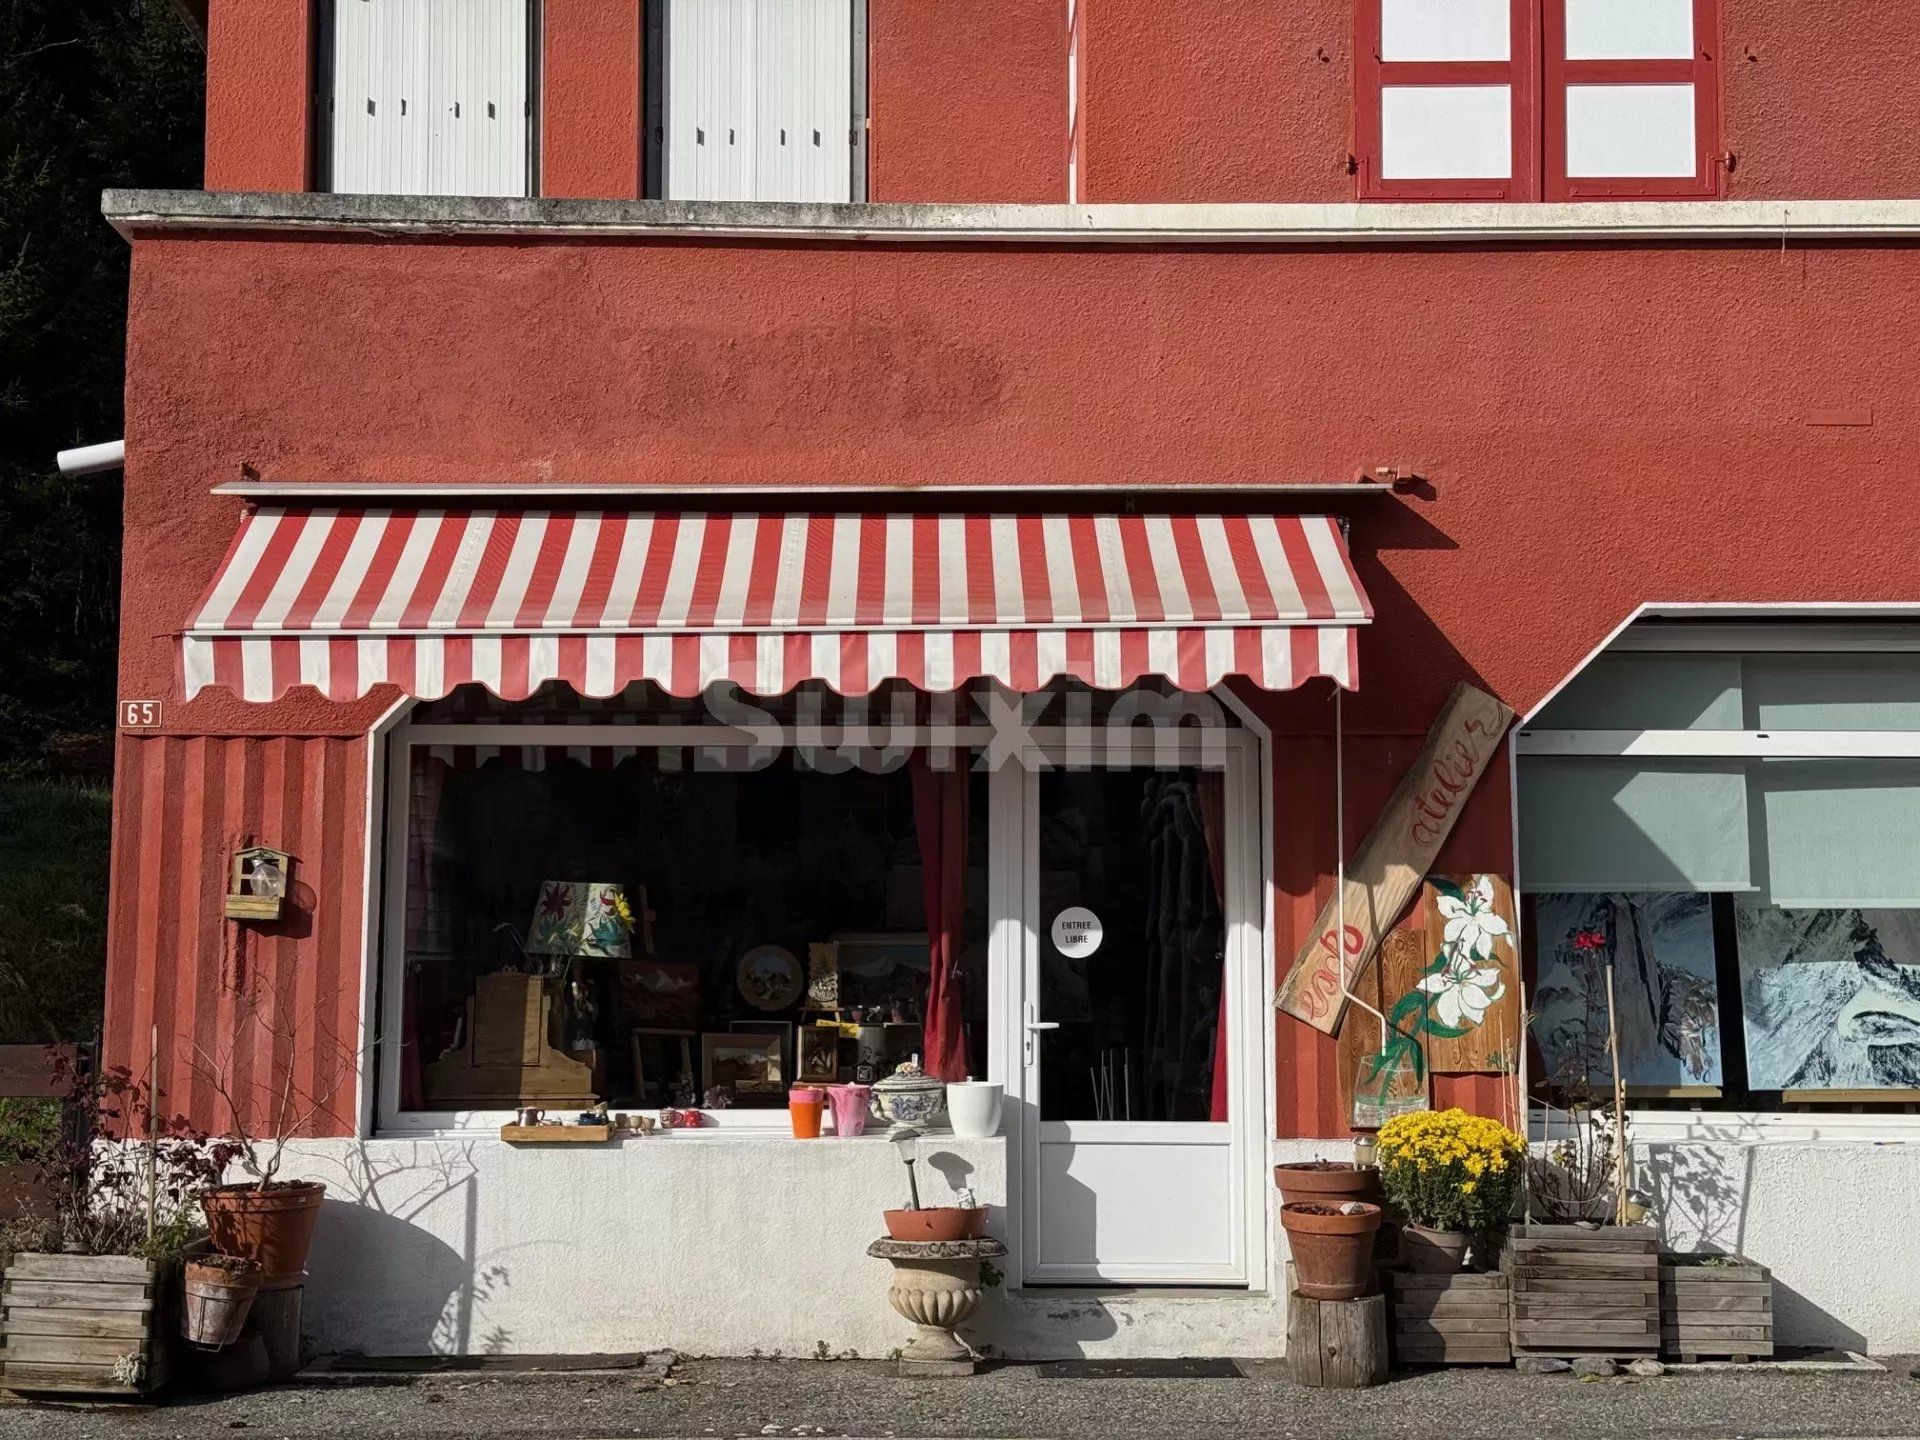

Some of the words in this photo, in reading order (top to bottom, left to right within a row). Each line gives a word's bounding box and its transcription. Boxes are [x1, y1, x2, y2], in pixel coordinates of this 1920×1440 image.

[127, 703, 154, 724] 65
[1061, 921, 1092, 930] ENTREE
[1065, 935, 1089, 944] LIBRE
